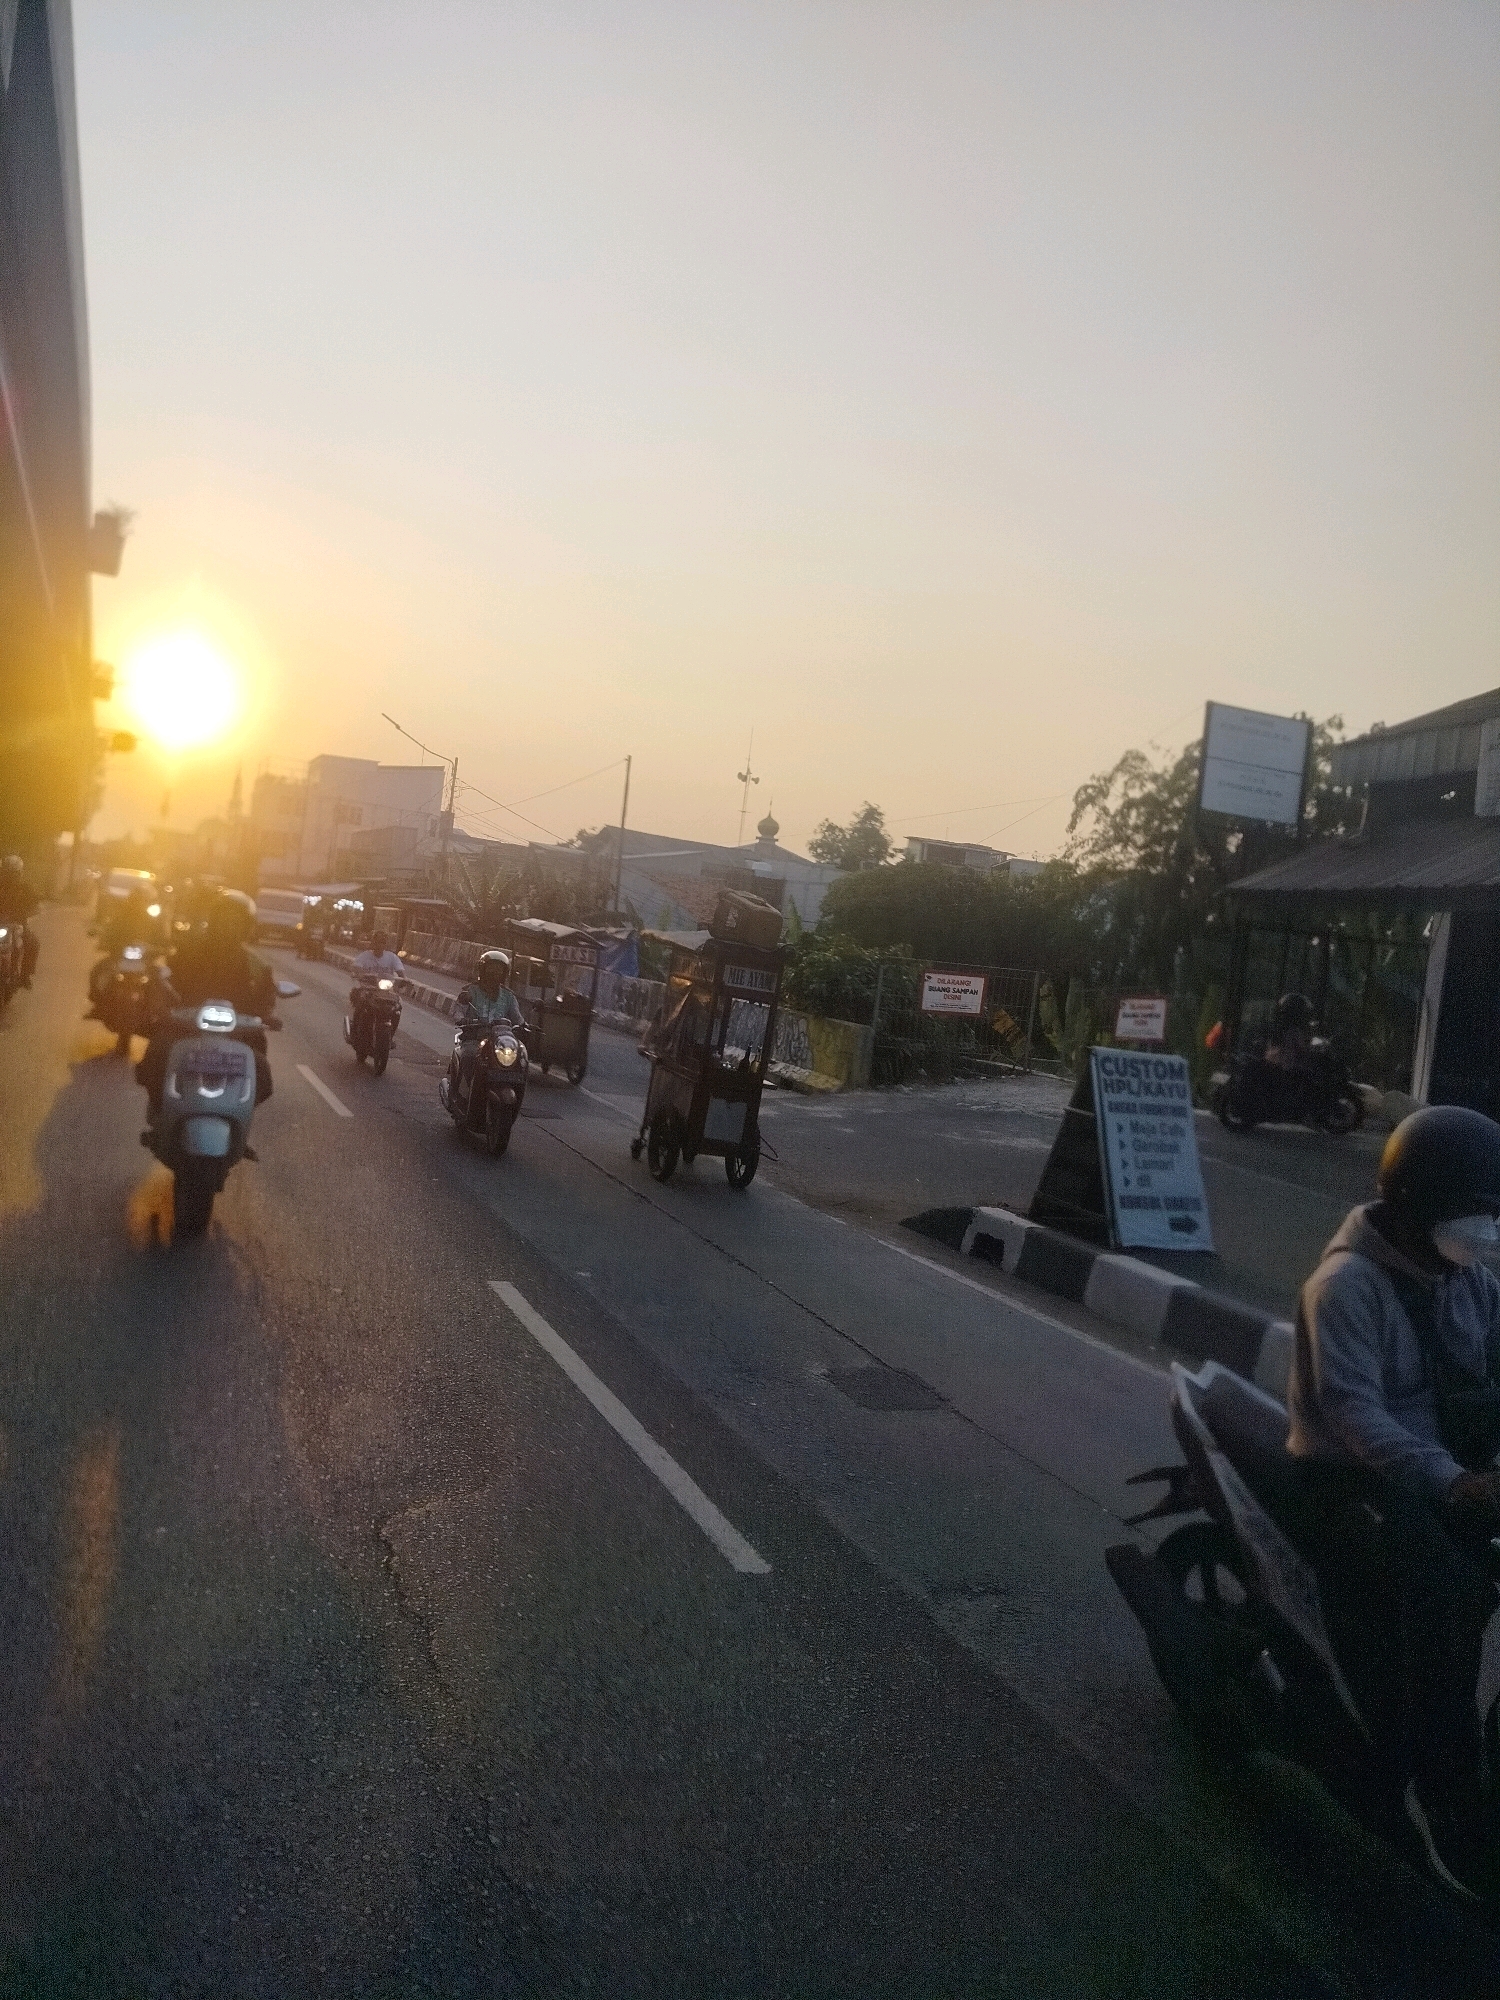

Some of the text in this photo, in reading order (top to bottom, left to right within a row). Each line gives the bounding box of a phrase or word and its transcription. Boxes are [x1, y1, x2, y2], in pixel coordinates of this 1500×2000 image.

[728, 966, 745, 984] MIE
[928, 985, 978, 995] BUANG SAMPAH
[1101, 1055, 1185, 1081] CUSTOM
